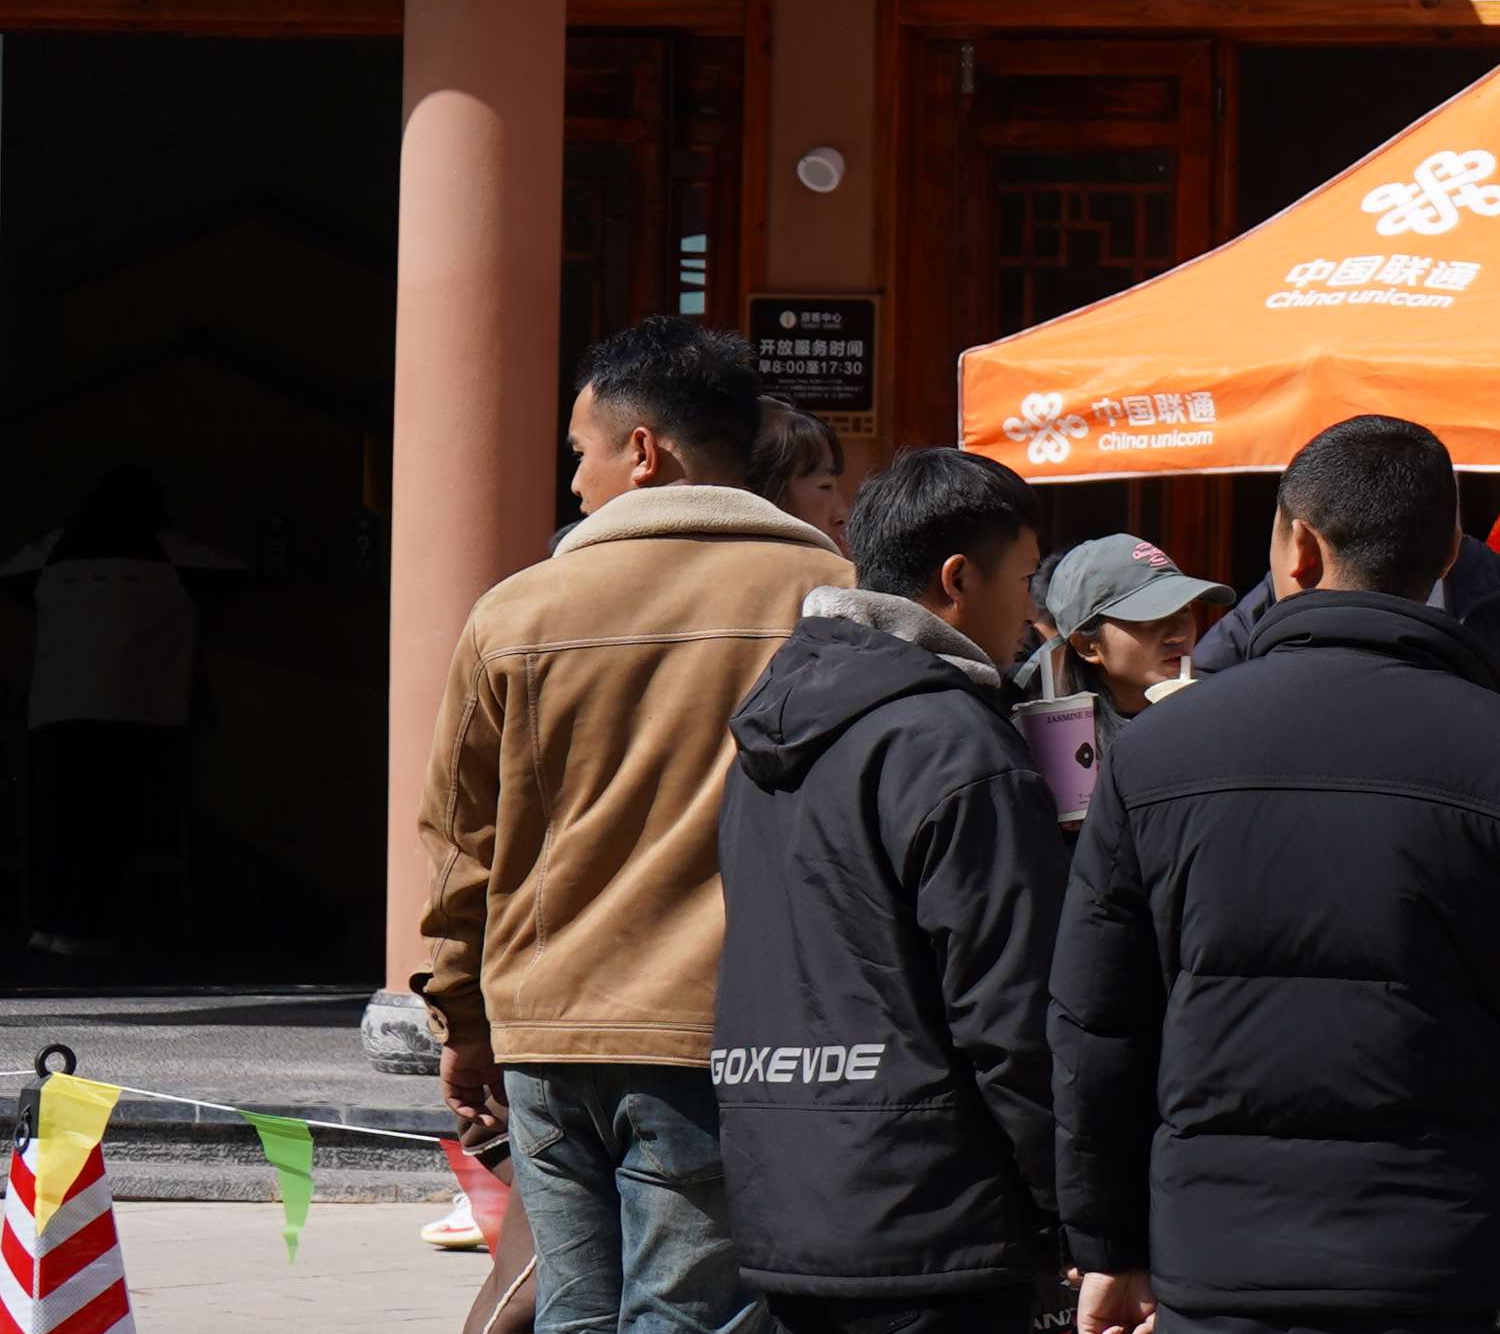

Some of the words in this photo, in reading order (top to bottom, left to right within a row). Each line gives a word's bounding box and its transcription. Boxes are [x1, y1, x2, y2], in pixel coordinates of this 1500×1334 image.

[1285, 254, 1482, 292] 中国联通
[1265, 287, 1347, 309] China
[1347, 287, 1454, 308] unicom
[760, 339, 863, 357] 开放服务时间
[1091, 392, 1217, 427] 中国联通
[1098, 432, 1148, 451] China
[1151, 429, 1214, 449] unicom
[710, 1043, 887, 1085] GOXEVDE
